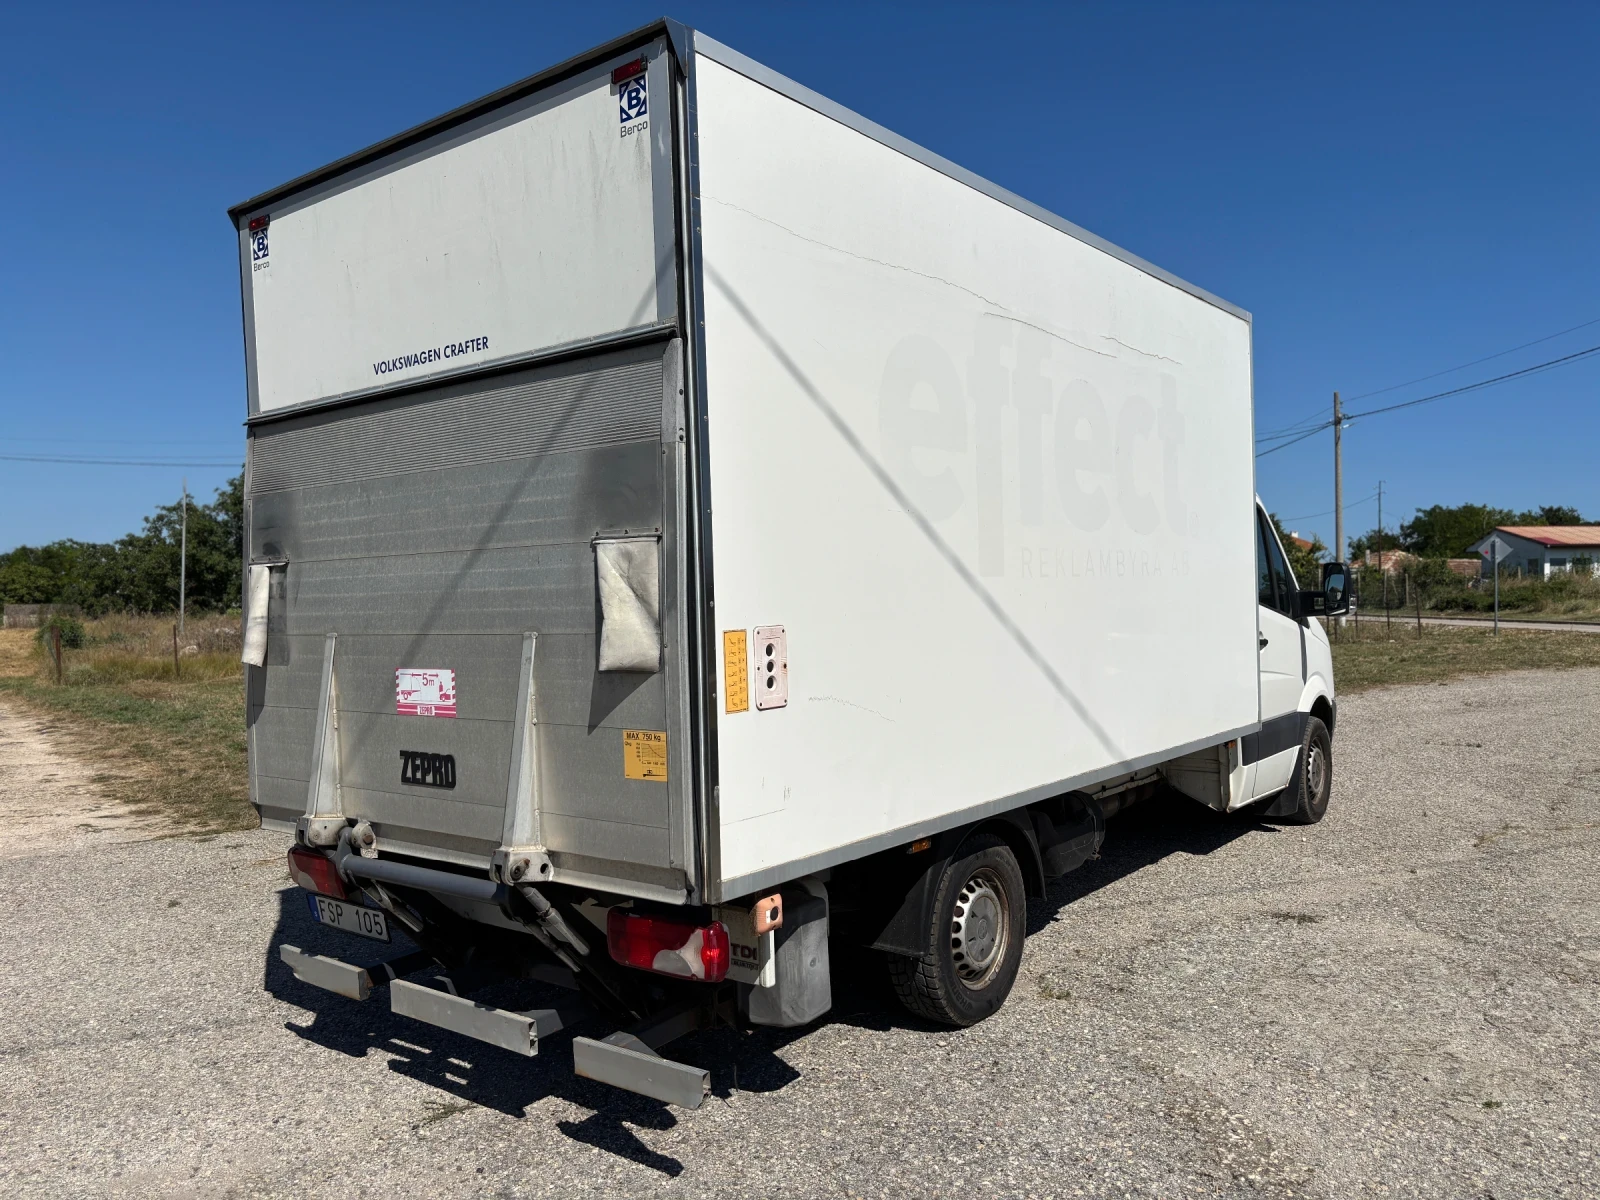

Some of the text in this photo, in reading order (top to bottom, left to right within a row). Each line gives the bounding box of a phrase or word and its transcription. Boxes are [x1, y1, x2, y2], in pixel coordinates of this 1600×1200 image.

[620, 121, 648, 138] Berco
[253, 261, 270, 271] Berco
[373, 336, 489, 375] VOLKSWAGEN CRAFTER
[626, 732, 639, 740] MAX
[642, 733, 653, 741] 750
[318, 899, 384, 936] FSP 105
[730, 942, 757, 960] TDI
